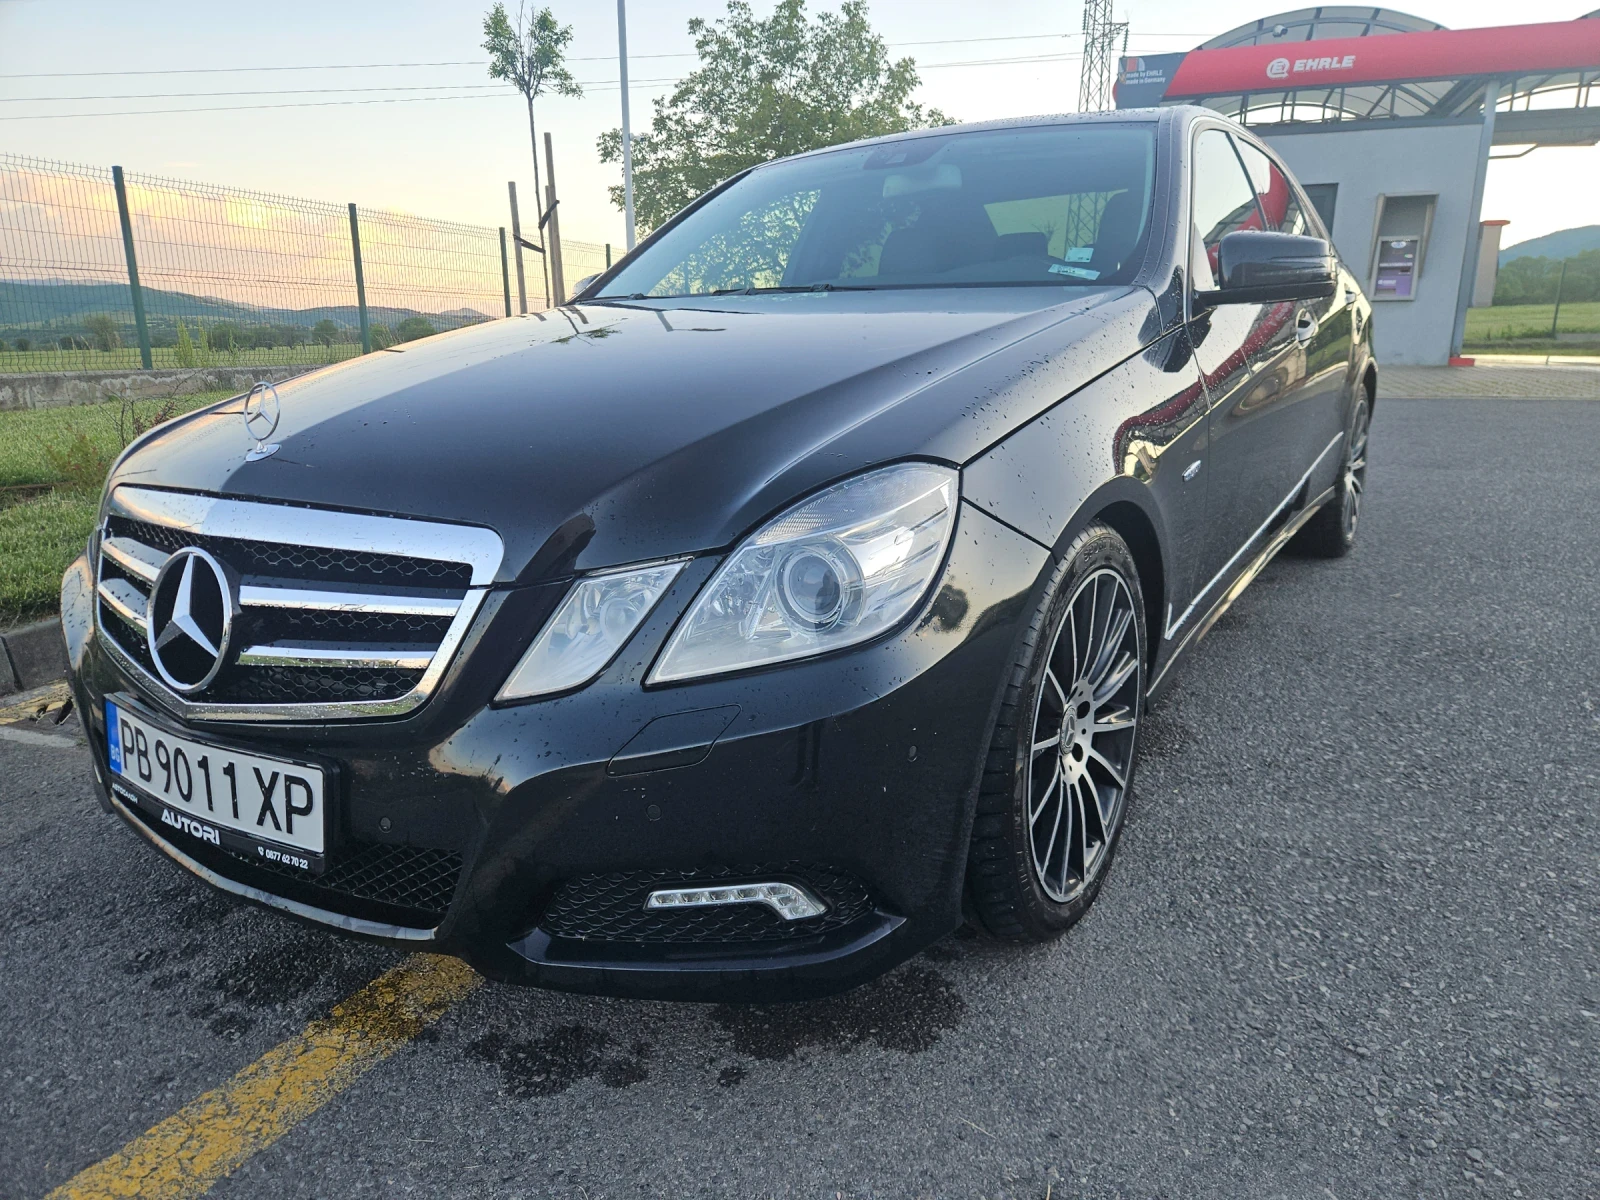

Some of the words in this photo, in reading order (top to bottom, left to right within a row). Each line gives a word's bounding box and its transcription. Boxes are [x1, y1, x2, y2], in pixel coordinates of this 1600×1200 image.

[1293, 55, 1356, 72] EHRLE
[110, 744, 120, 763] BG
[160, 808, 221, 846] AUTORI
[281, 854, 291, 865] 62
[290, 856, 299, 867] 70
[299, 859, 309, 870] 22
